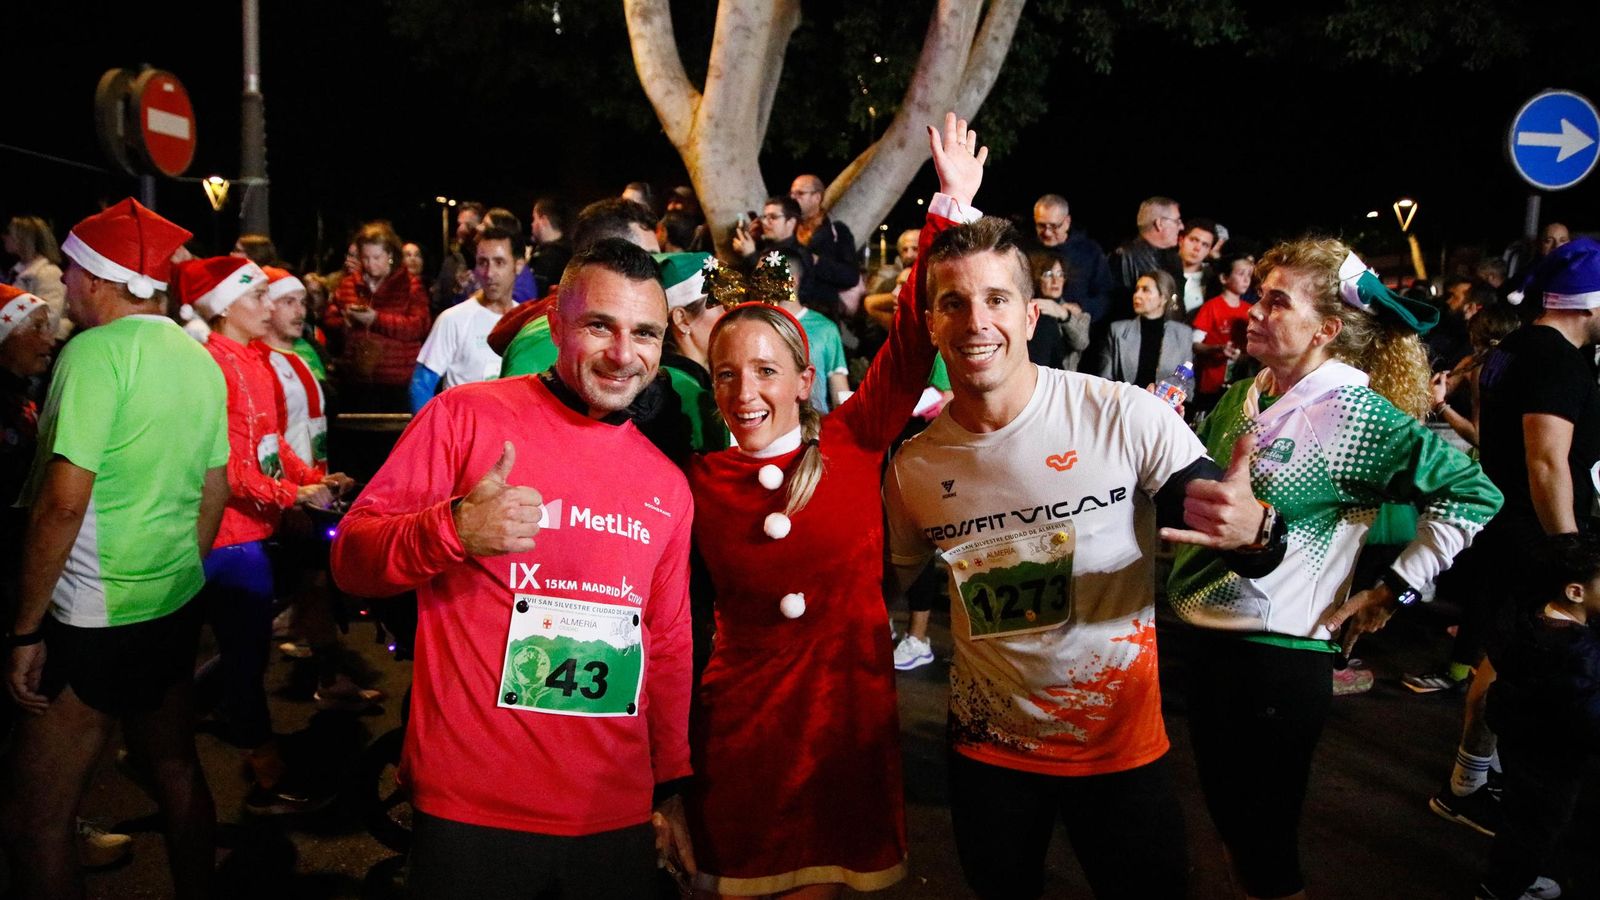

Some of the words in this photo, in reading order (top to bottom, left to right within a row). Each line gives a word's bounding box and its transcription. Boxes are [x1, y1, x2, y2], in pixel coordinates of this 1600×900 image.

[570, 505, 650, 544] MetLife
[1004, 531, 1028, 541] CIUDAD
[509, 562, 541, 589] IX
[545, 578, 578, 590] 15KM
[581, 581, 621, 598] MADRID
[972, 574, 1068, 622] 1273
[538, 599, 553, 607] SAN
[554, 601, 590, 612] SILVESTRE
[592, 606, 616, 615] CIUDAD
[560, 617, 598, 628] ALMERÍA
[545, 658, 609, 700] 43
